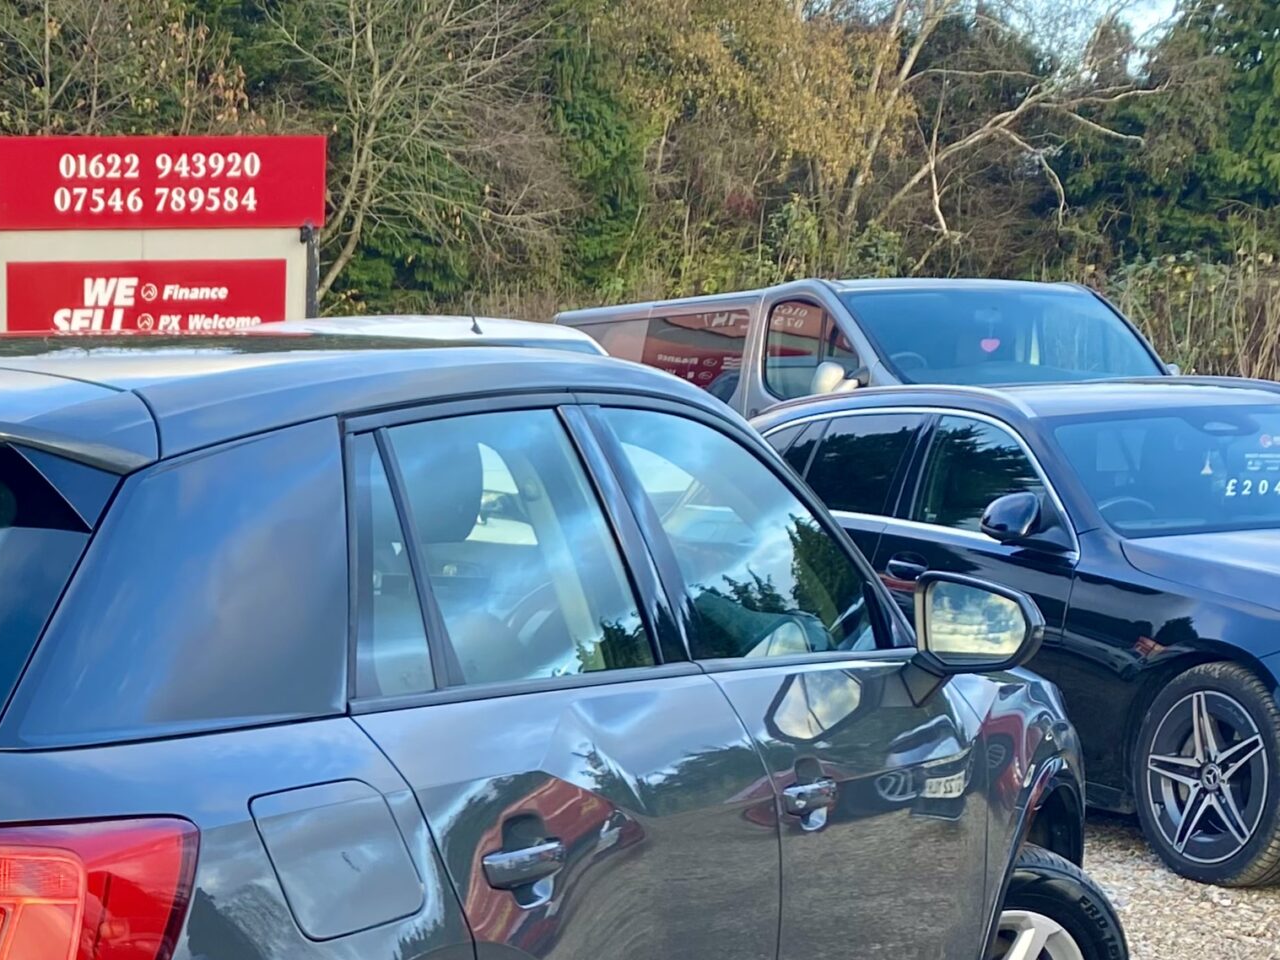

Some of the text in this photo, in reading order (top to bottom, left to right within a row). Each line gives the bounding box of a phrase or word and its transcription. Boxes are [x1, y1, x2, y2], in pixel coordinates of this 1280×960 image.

[58, 152, 261, 179] 01622 943920
[53, 186, 258, 212] 07546 789584
[83, 277, 138, 307] WE
[162, 284, 229, 301] Finance
[158, 314, 261, 331] PX Welcome
